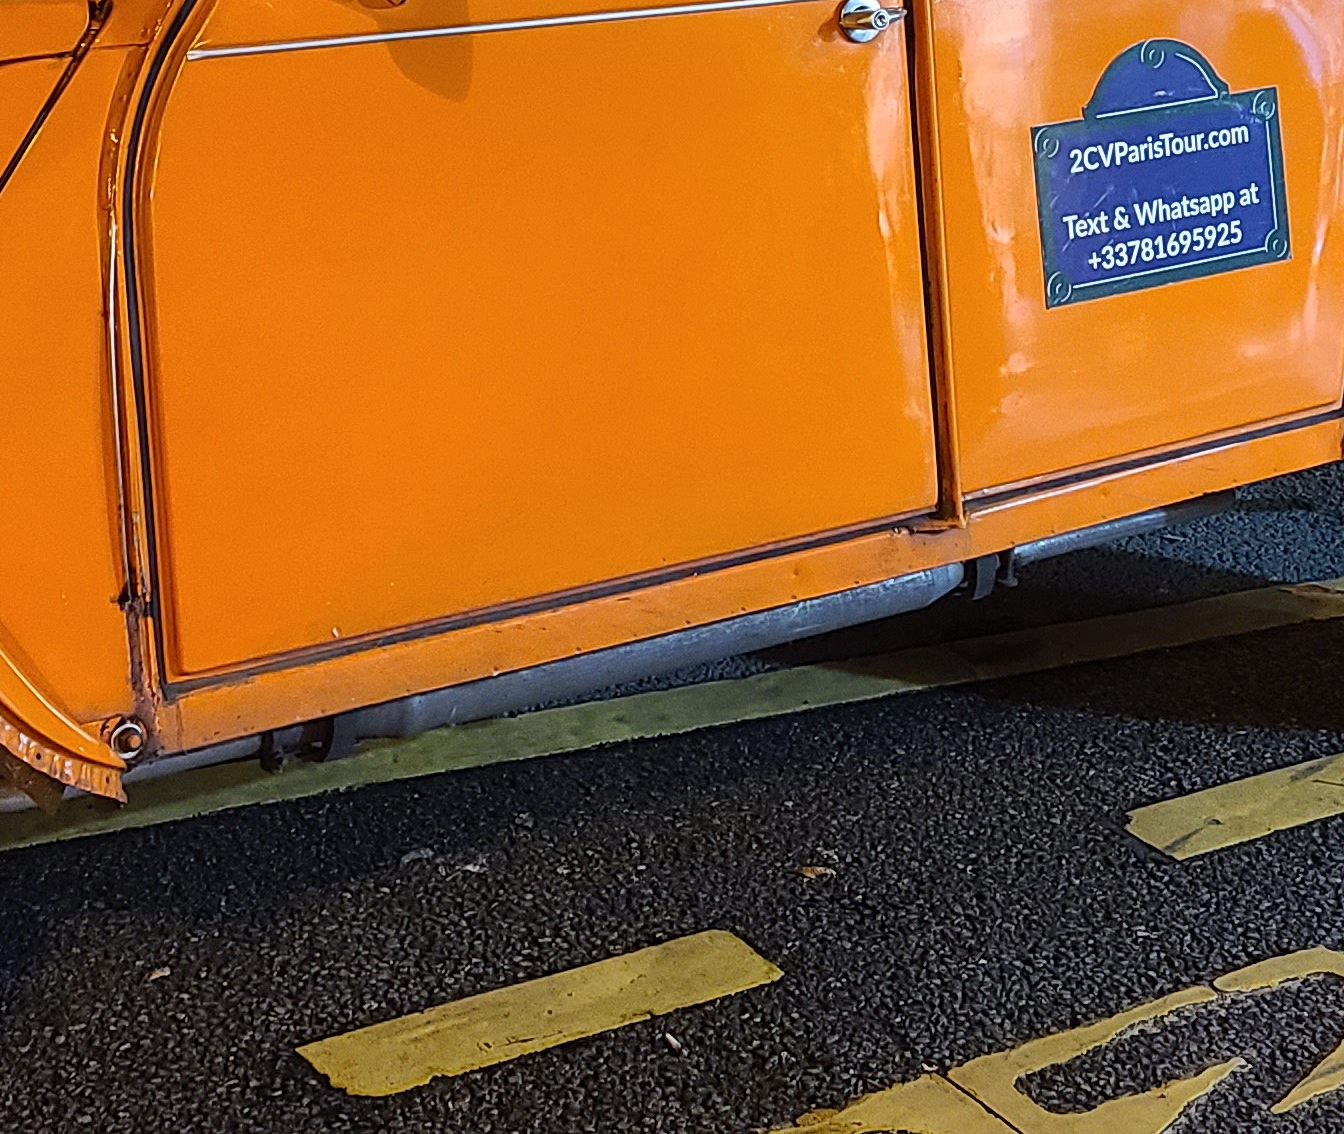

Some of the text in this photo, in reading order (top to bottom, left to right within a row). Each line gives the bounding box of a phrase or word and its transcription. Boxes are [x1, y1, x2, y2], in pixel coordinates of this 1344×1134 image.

[1069, 124, 1250, 174] 2CVParisTour.com
[1062, 182, 1260, 240] Text & Whatsapp at
[1087, 219, 1243, 271] +33781695925
